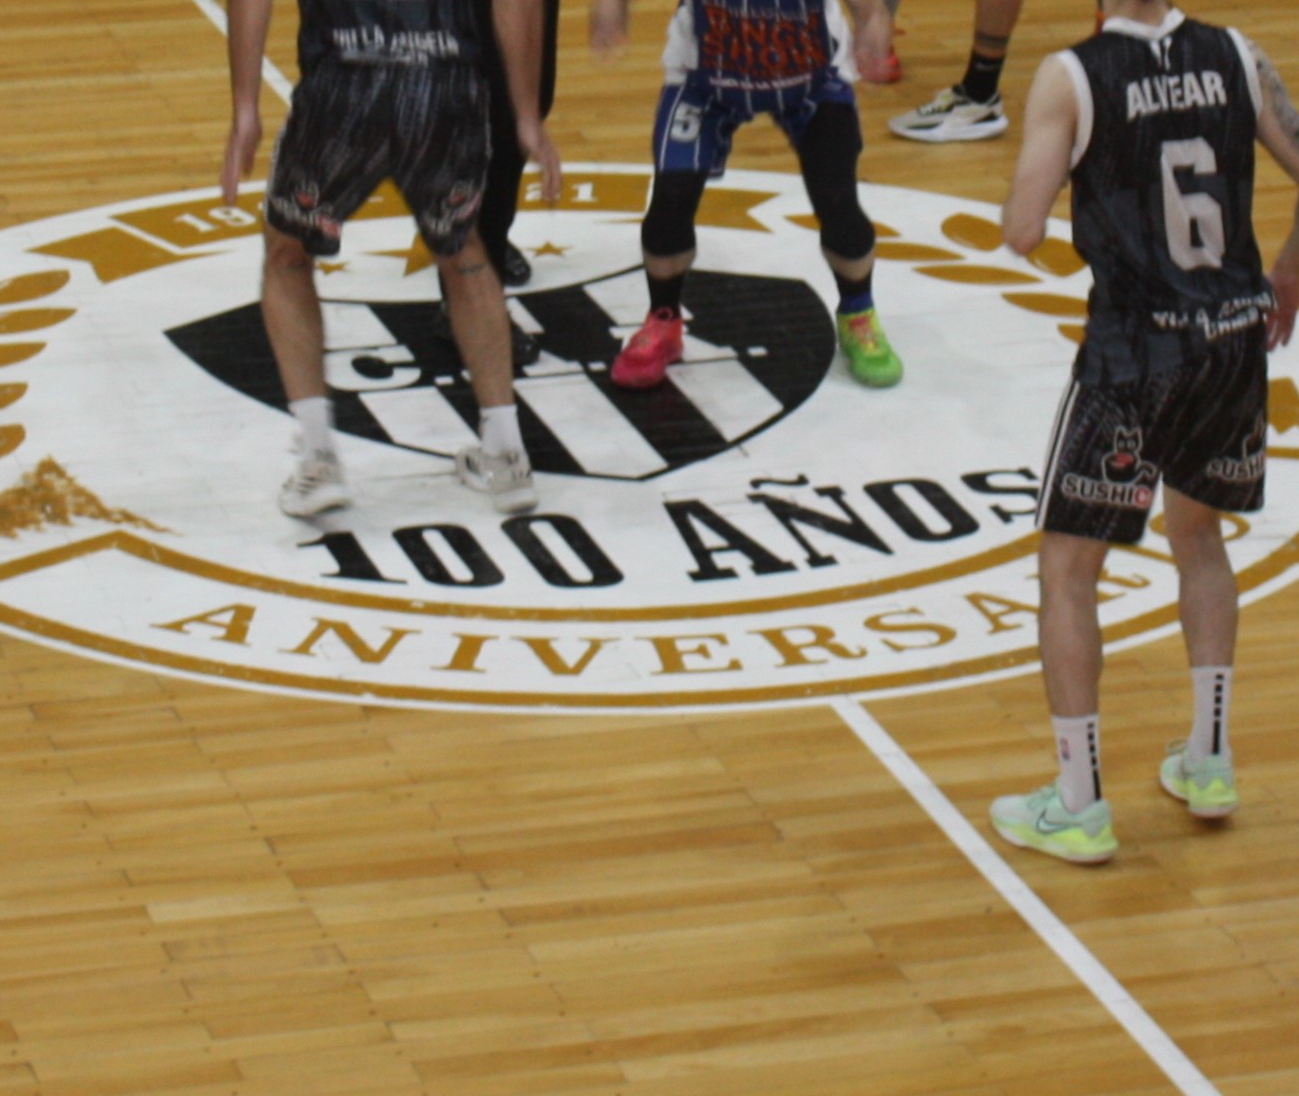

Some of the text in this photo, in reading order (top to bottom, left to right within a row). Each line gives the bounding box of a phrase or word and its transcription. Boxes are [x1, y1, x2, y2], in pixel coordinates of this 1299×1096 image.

[669, 101, 701, 143] 5
[1125, 69, 1228, 124] ALVEAR
[1160, 135, 1226, 272] 6
[298, 467, 1039, 588] 100 AÑOS
